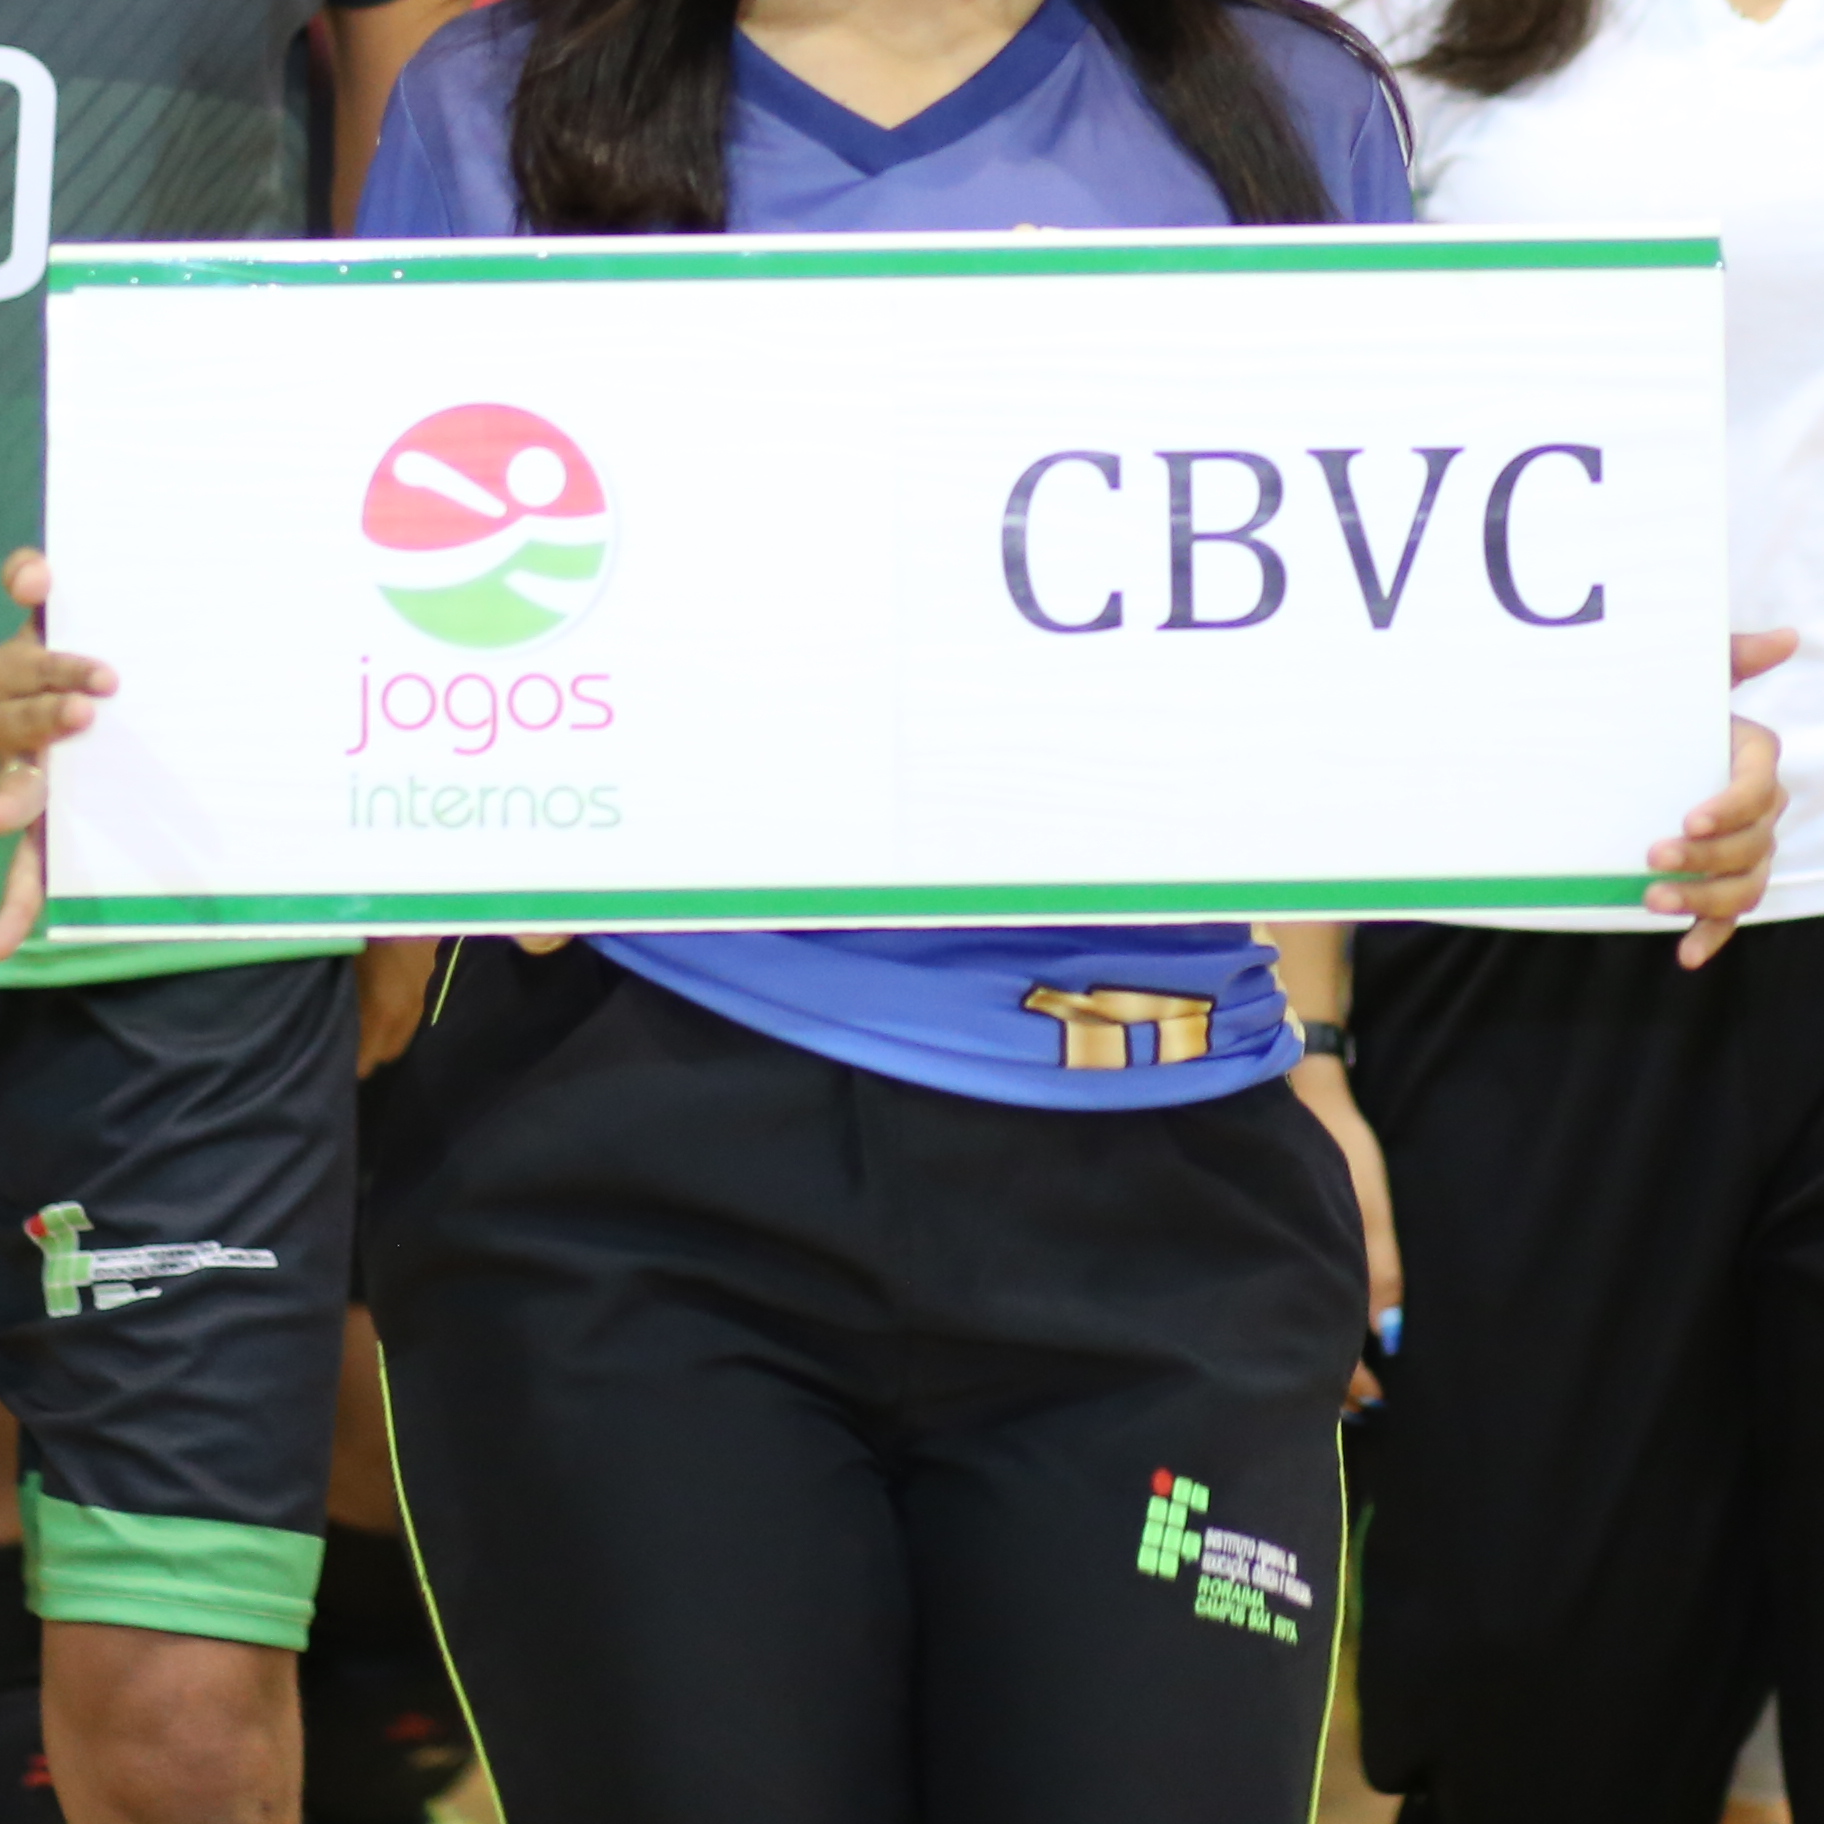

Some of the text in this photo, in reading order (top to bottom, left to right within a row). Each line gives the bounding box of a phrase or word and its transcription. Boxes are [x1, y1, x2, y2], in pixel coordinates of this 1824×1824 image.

[1001, 442, 1606, 634] CBVC
[344, 654, 616, 757] jogos
[349, 772, 623, 830] internos
